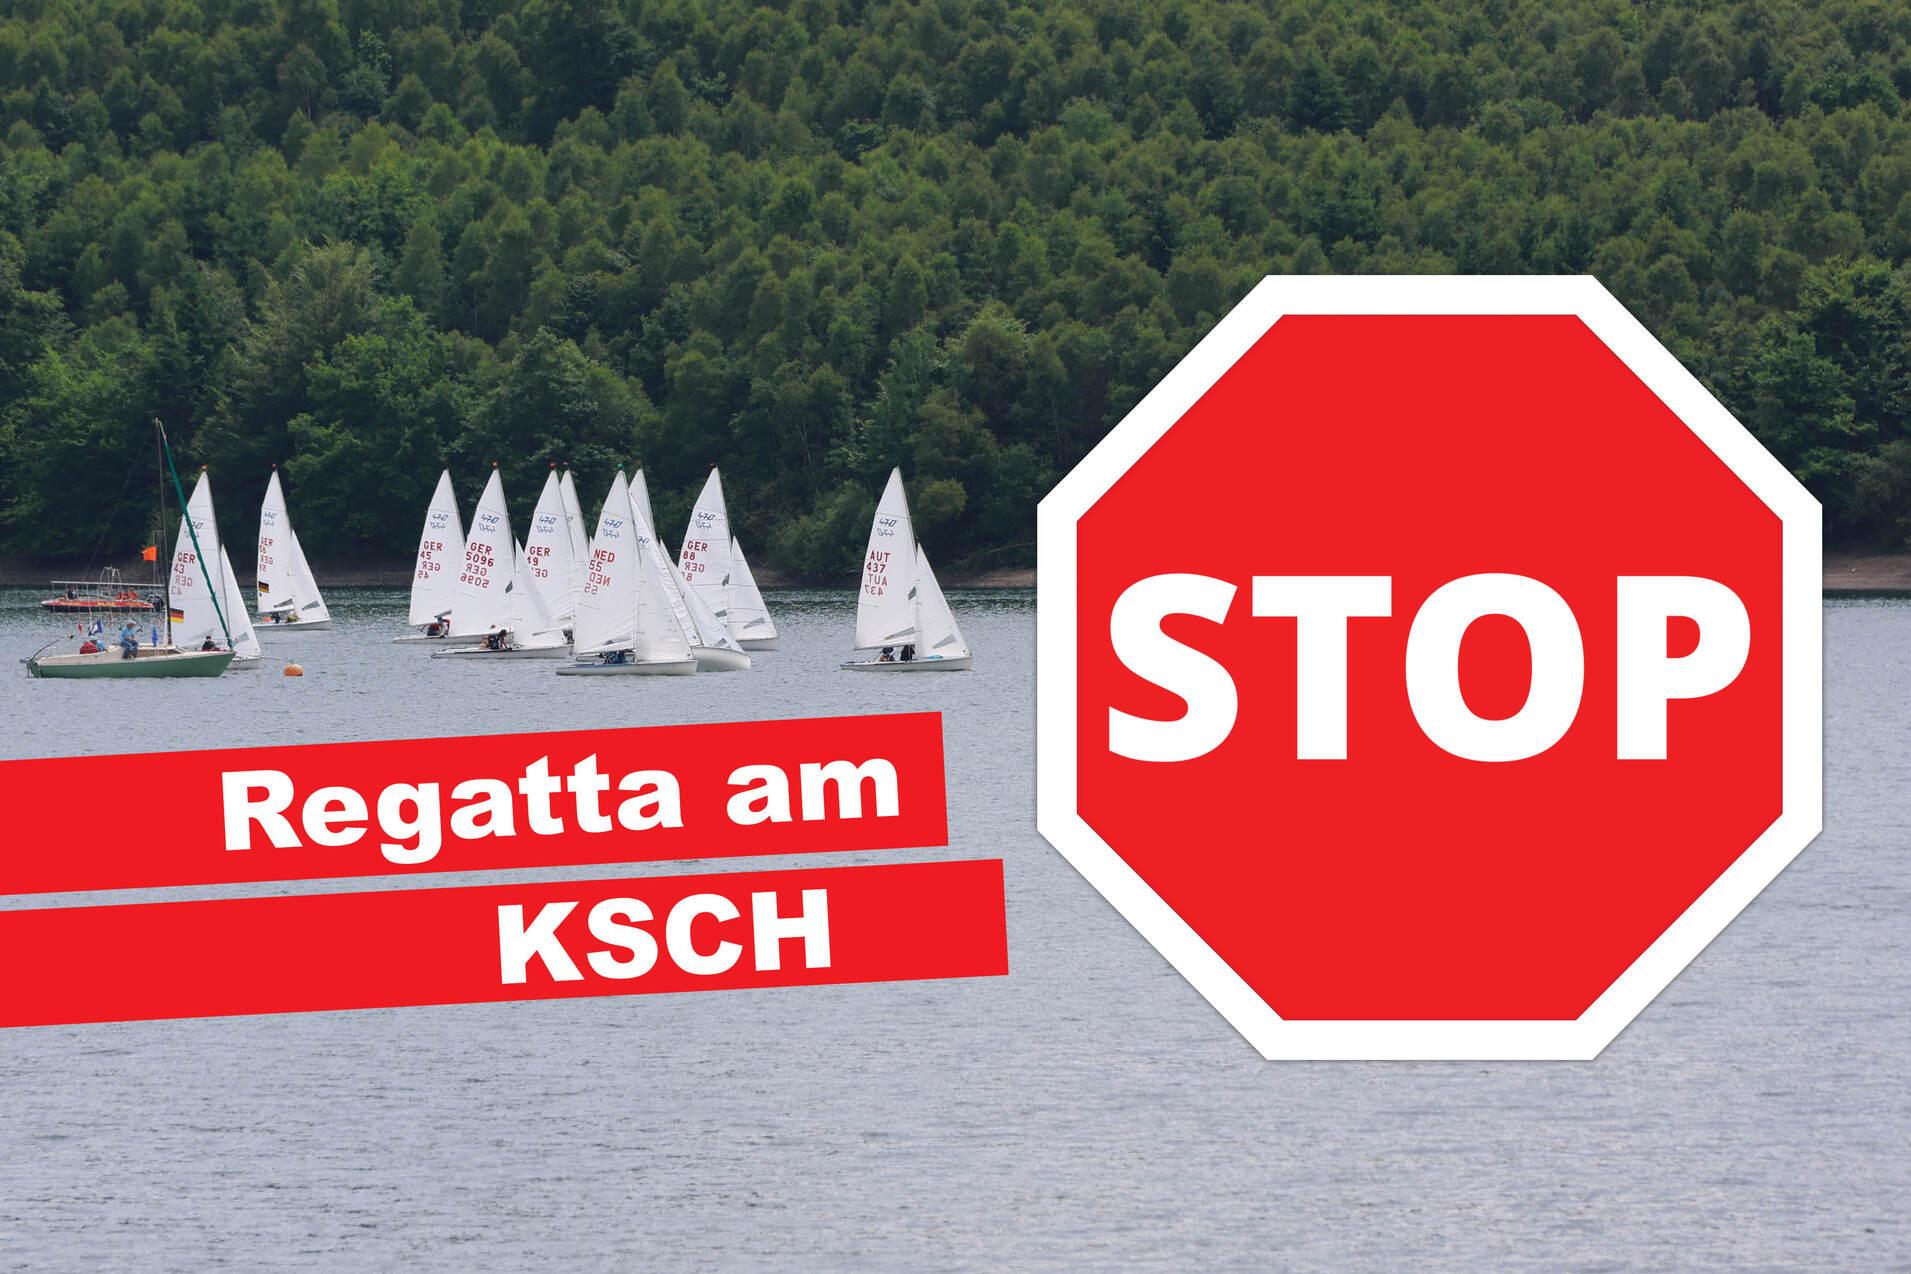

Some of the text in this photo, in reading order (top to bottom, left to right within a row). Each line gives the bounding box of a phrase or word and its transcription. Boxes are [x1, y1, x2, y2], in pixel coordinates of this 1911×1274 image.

[432, 513, 448, 521] 470
[481, 513, 500, 524] 470
[539, 516, 557, 524] 470
[697, 512, 716, 520] 470
[604, 518, 623, 528] 470
[879, 519, 897, 527] 470
[261, 537, 273, 546] GER
[423, 541, 443, 551] GER
[687, 541, 708, 552] GER
[470, 542, 492, 555] GER
[529, 546, 551, 557] GER
[178, 552, 196, 564] GER
[420, 551, 432, 560] 45
[465, 552, 494, 567] 5096
[527, 556, 539, 566] 19
[593, 548, 615, 563] NED
[683, 551, 696, 561] 88
[869, 550, 891, 563] AUT
[174, 563, 185, 574] 43
[589, 560, 603, 572] 55
[866, 561, 886, 574] 437
